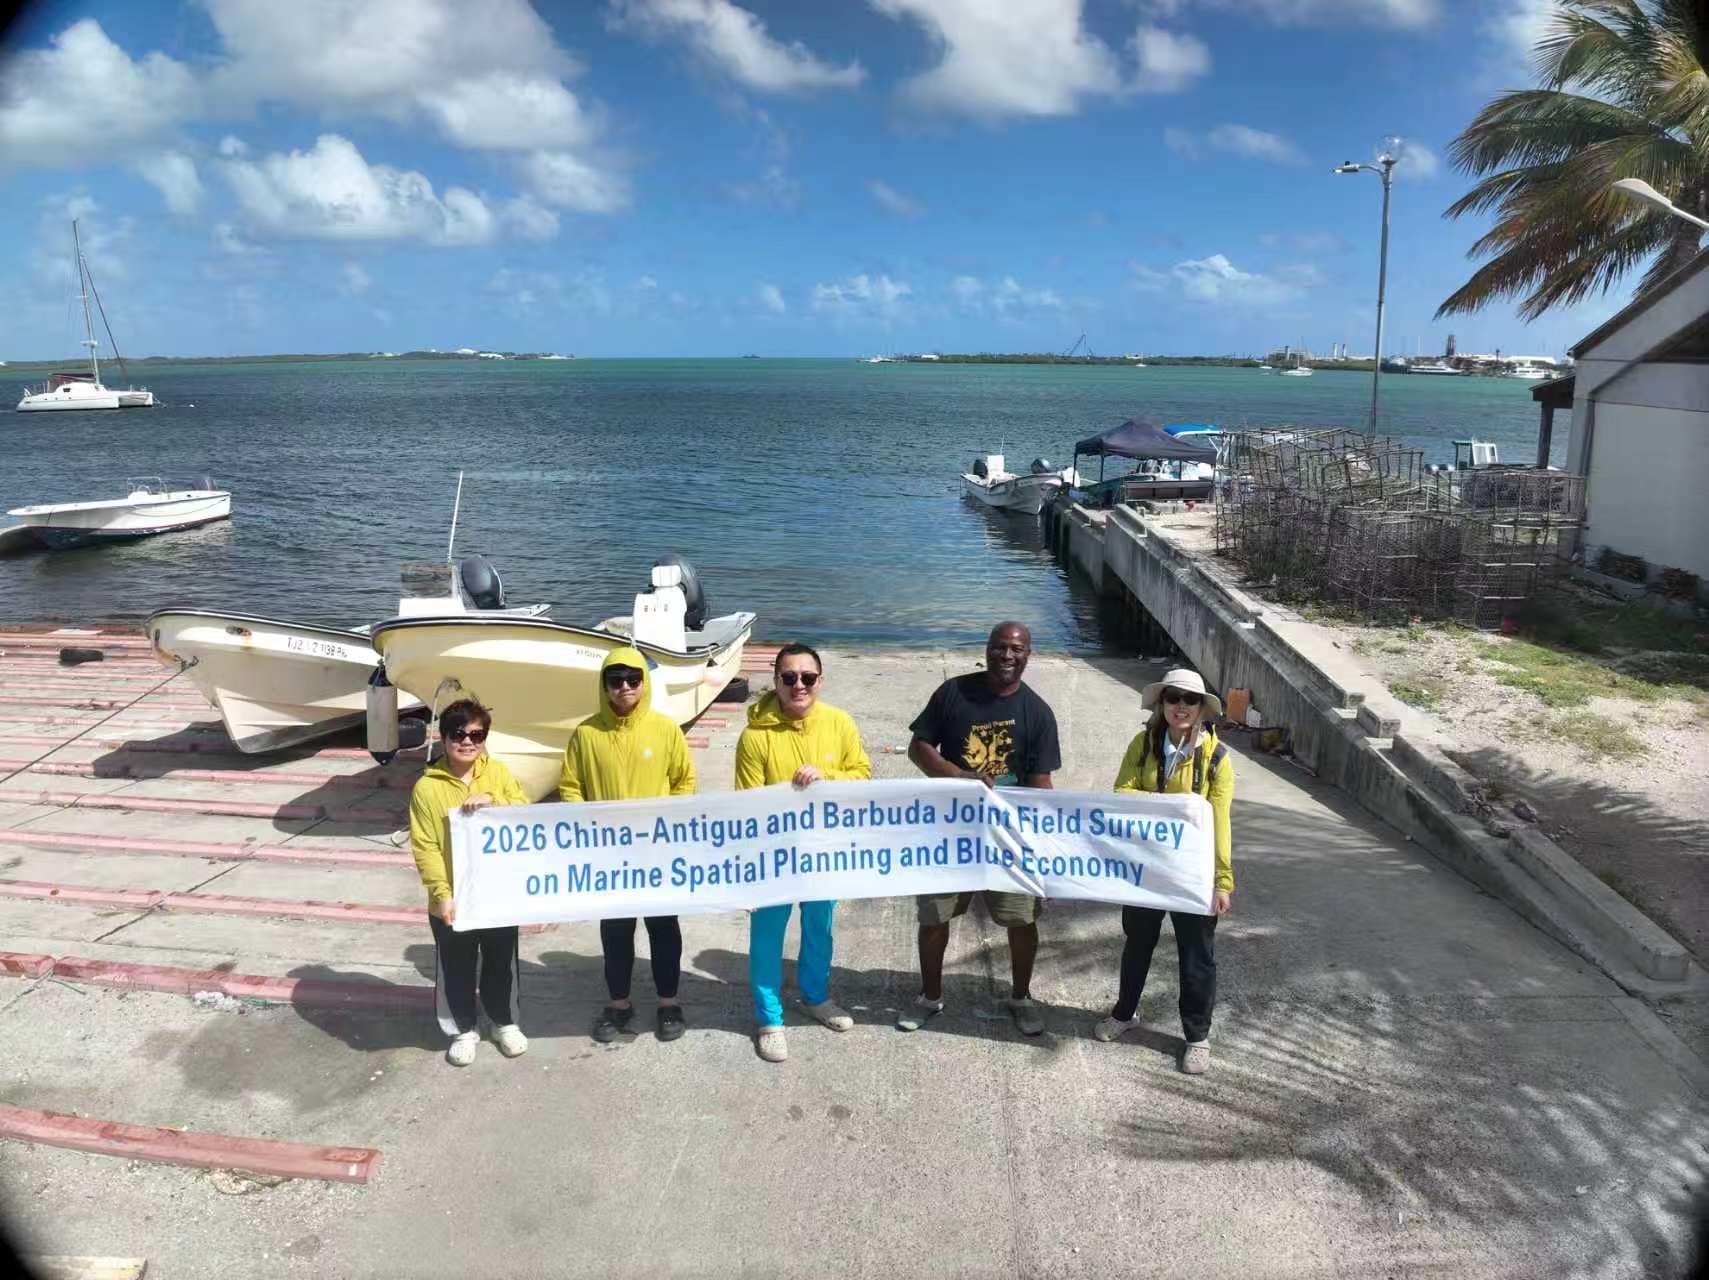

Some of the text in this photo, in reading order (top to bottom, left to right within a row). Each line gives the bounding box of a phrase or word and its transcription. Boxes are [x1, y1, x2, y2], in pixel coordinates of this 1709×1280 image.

[483, 824, 546, 853] 2026
[767, 803, 815, 835] and
[823, 799, 936, 829] Barbuda
[944, 797, 1011, 829] Joint
[1017, 805, 1081, 833] Field
[1089, 809, 1184, 848] Survey
[527, 837, 1143, 895] on Marine Spatial Planning and Blue Economy
